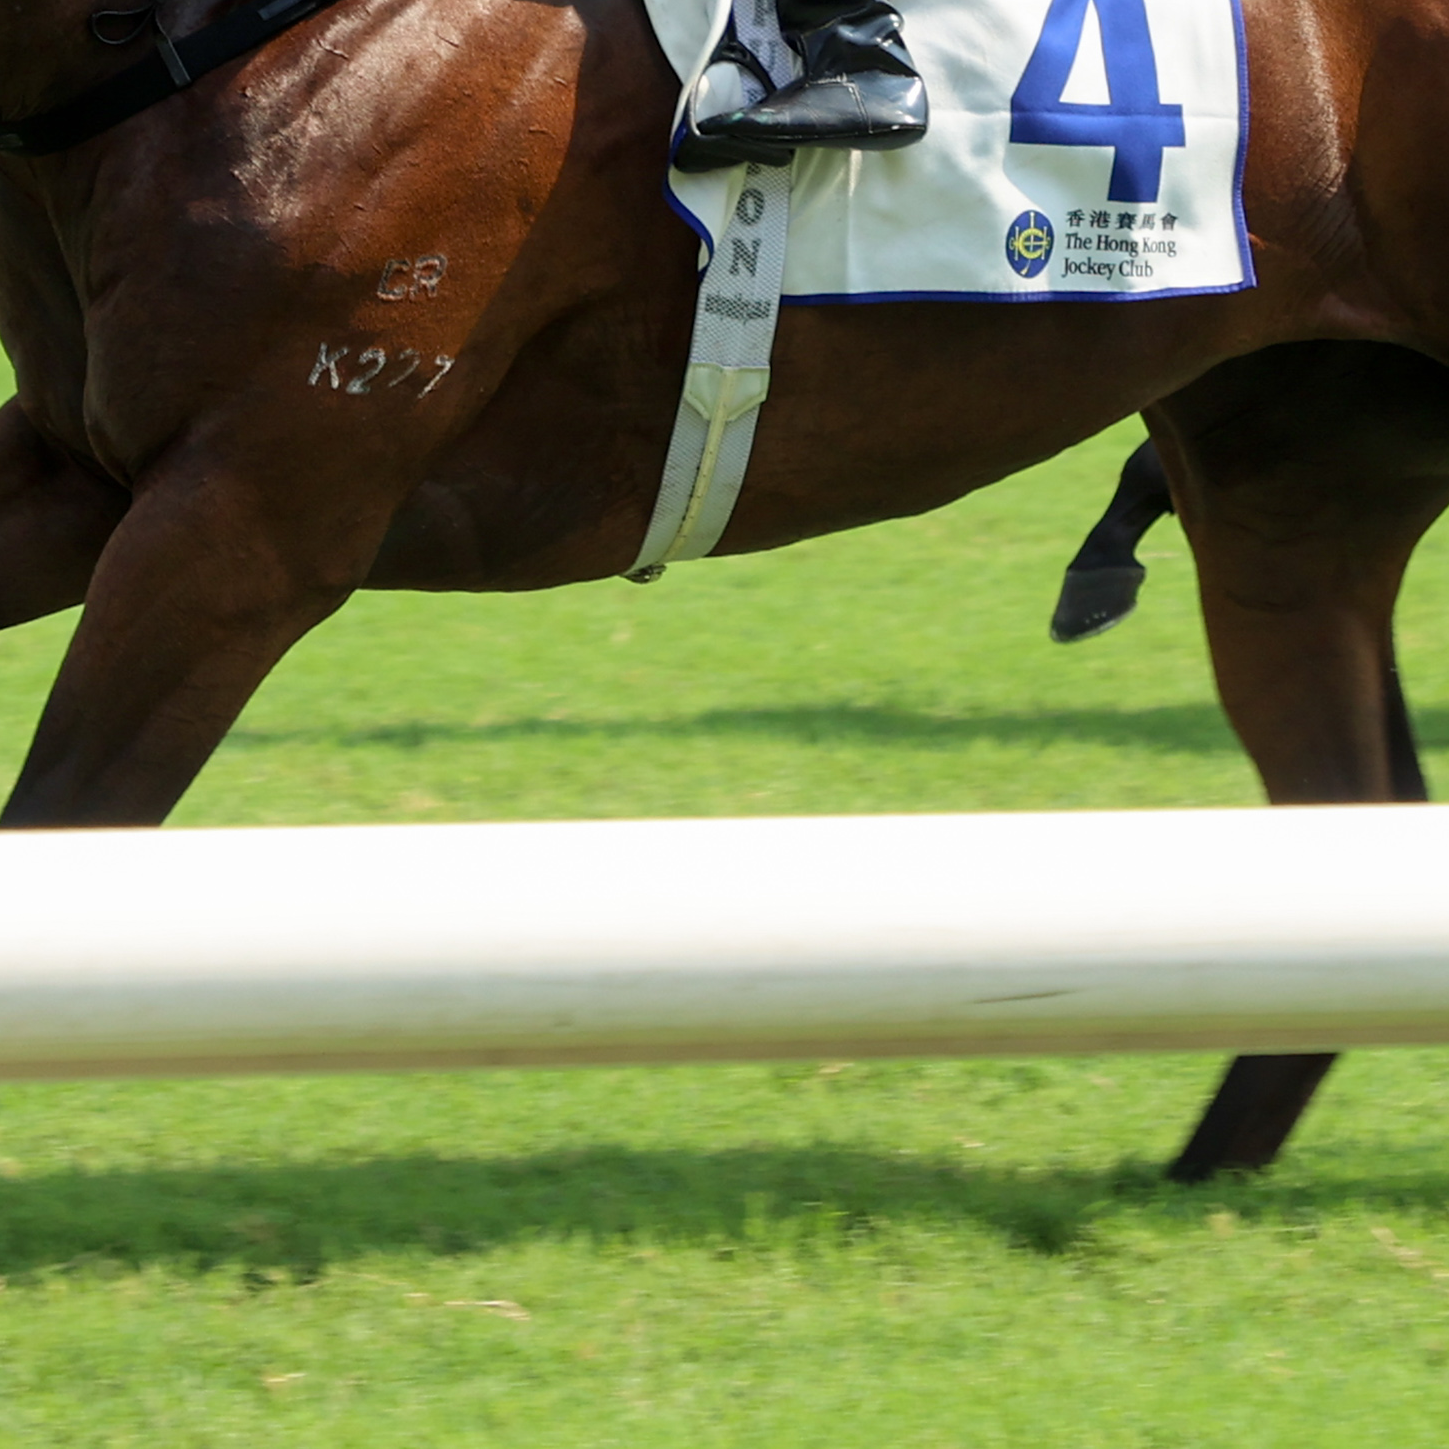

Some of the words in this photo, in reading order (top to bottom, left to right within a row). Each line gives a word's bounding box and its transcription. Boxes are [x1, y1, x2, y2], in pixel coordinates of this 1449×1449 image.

[1065, 209, 1179, 231] 香港賽馬會
[1065, 233, 1093, 250] The
[1096, 235, 1139, 256] Hong
[1142, 237, 1177, 256] Kong
[1061, 258, 1114, 280] Jockey
[1119, 260, 1153, 277] Club
